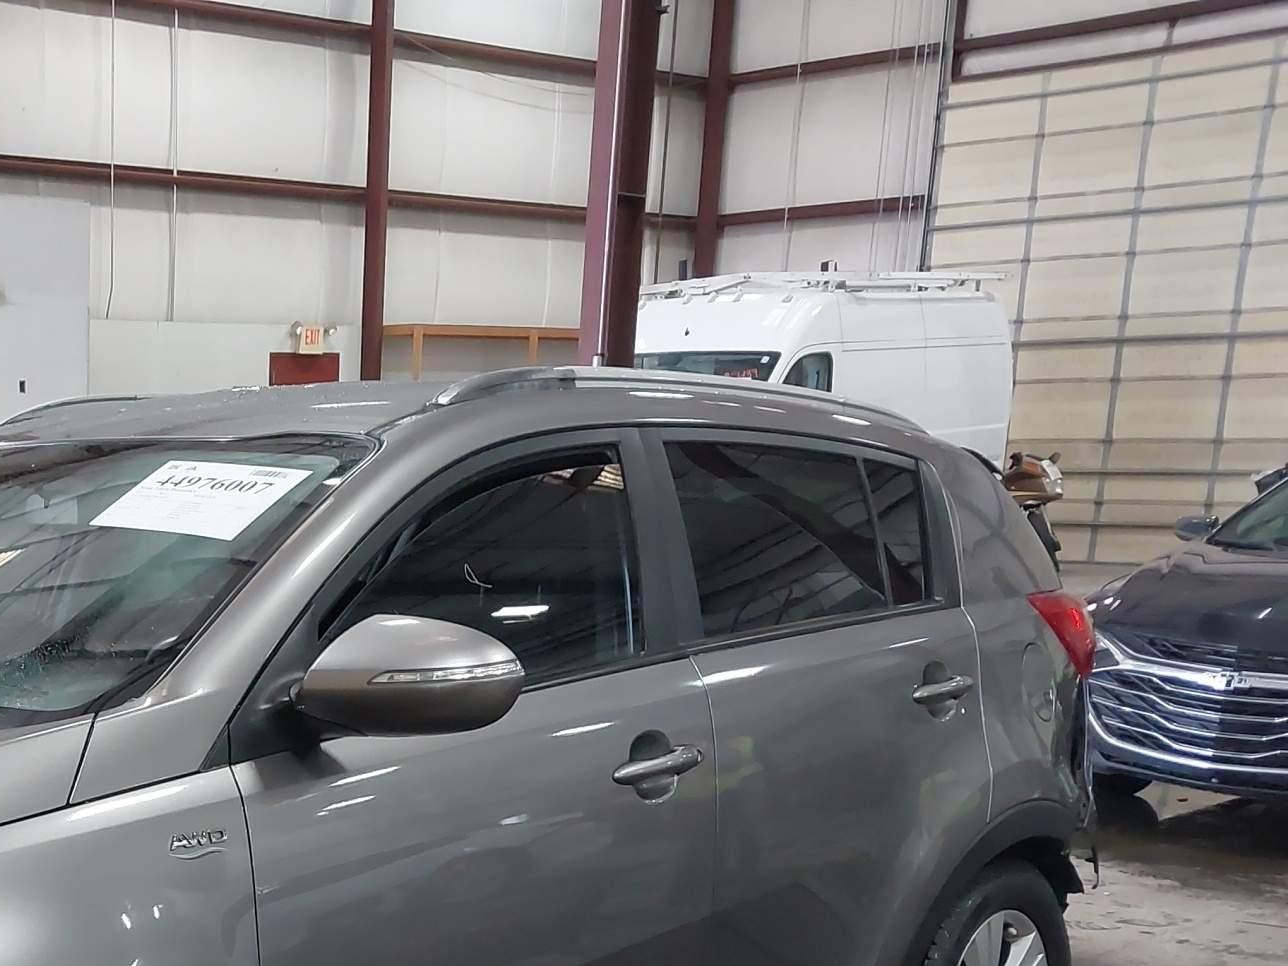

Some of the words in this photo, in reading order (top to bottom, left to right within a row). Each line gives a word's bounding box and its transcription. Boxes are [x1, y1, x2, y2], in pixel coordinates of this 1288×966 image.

[305, 329, 320, 345] EXIT
[156, 474, 275, 495] 44976007
[170, 829, 228, 852] AWD
